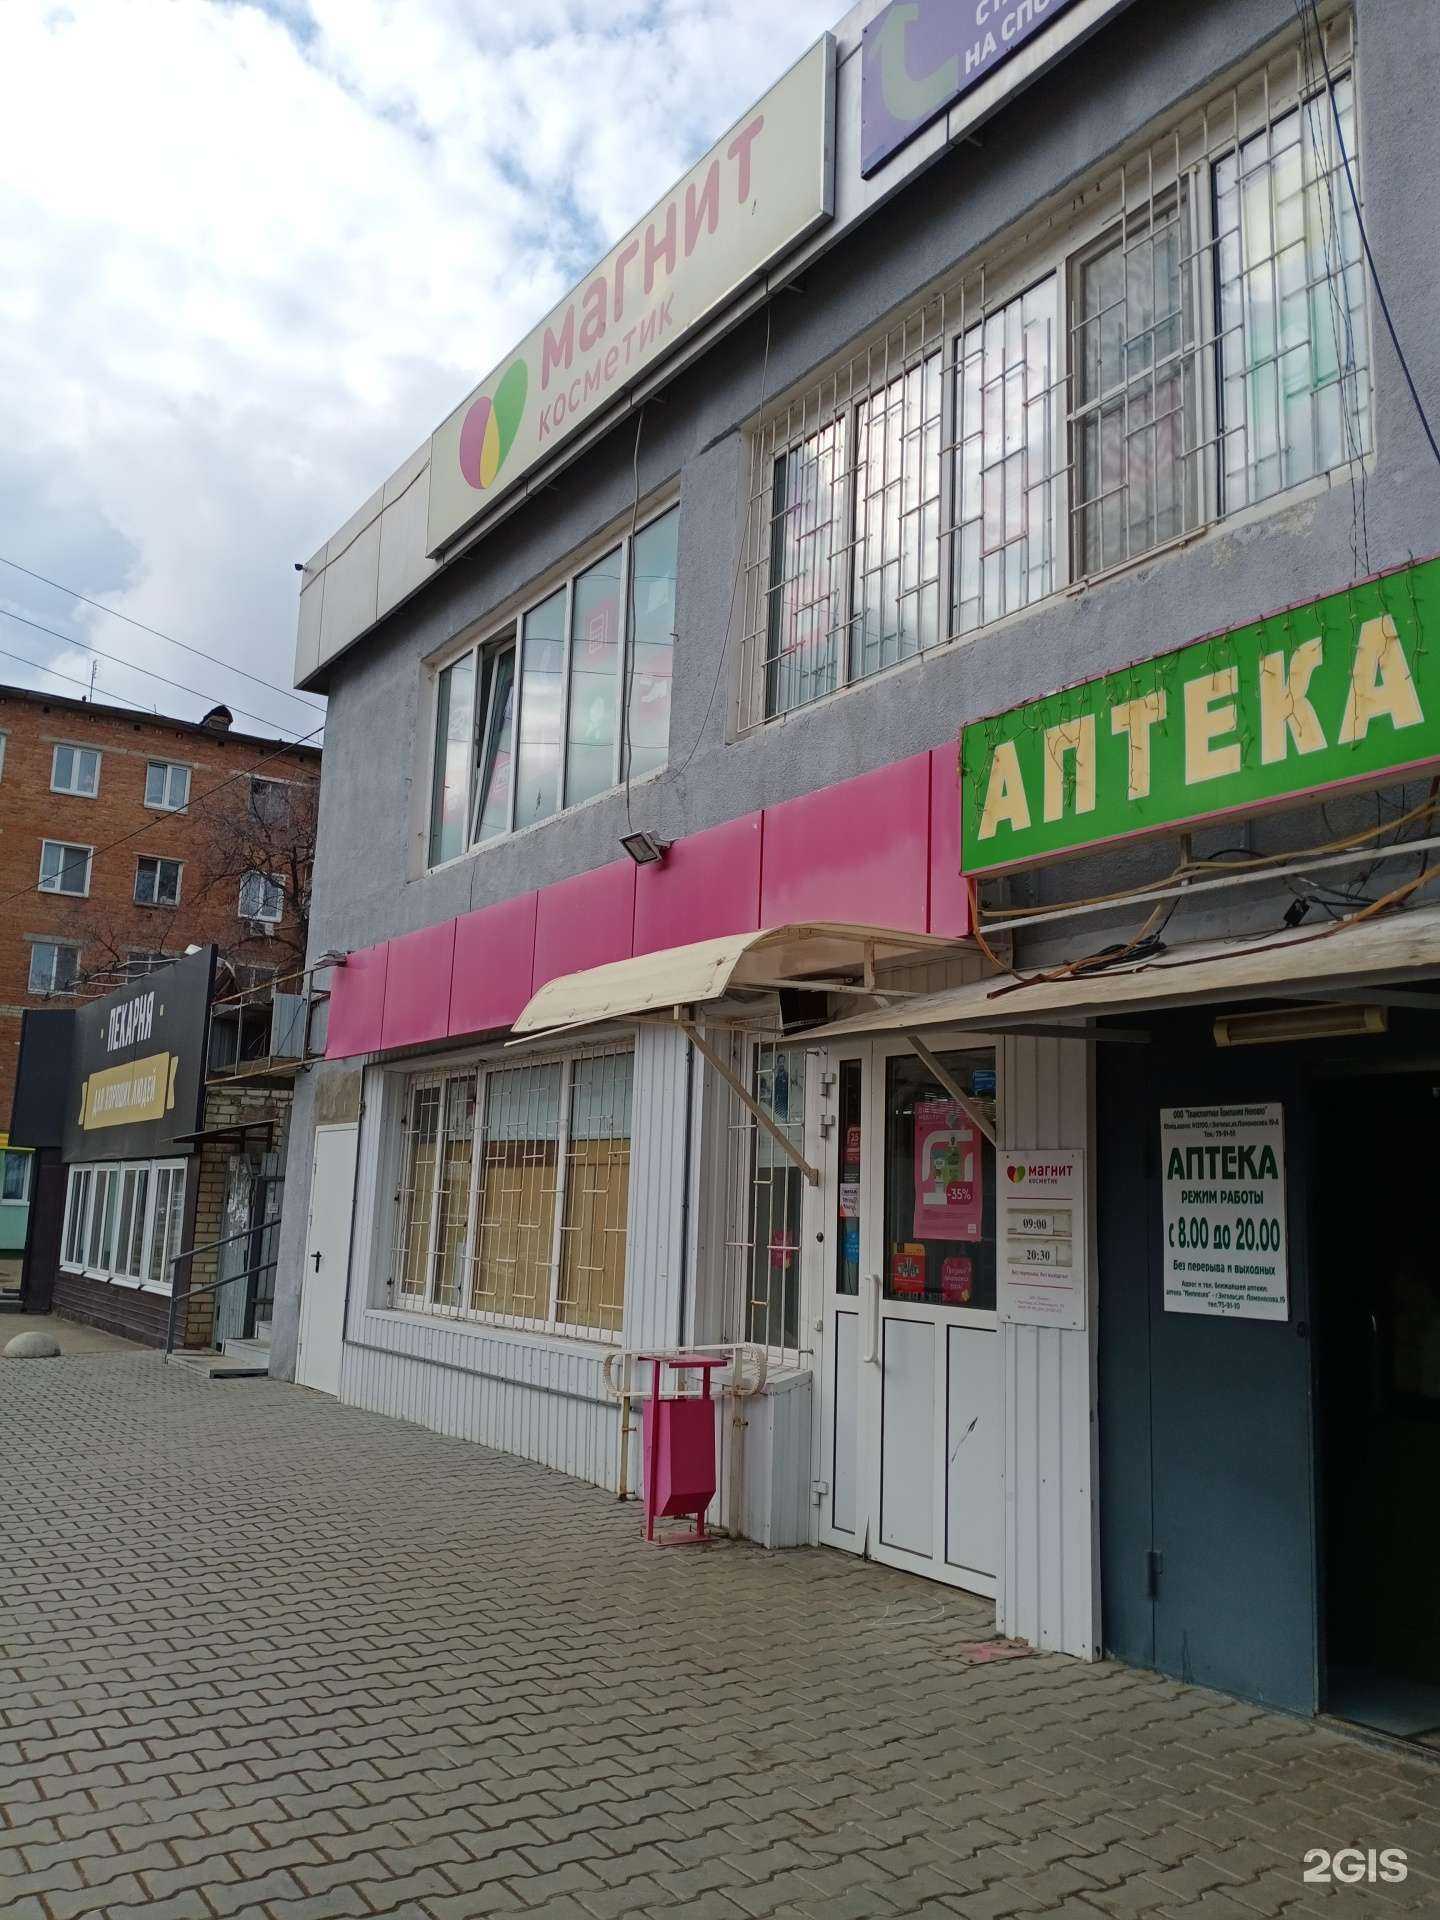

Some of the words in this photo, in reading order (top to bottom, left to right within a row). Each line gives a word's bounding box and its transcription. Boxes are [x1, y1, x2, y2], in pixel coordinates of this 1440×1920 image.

[965, 32, 998, 74] НА
[538, 291, 674, 442] косметик
[977, 613, 1425, 841] АПТЕКА
[107, 991, 155, 1052] ПЕКАРНЯ
[1167, 1145, 1279, 1181] АПТЕКА
[1181, 1190, 1217, 1204] РЕЖИМ
[1220, 1189, 1264, 1204] РАБОТЫ
[1023, 1218, 1047, 1229] 09:00
[1178, 1216, 1209, 1249] 8.00
[1213, 1224, 1231, 1250] до
[1235, 1217, 1281, 1252] 20.00
[1026, 1249, 1050, 1261] 20:30
[1173, 1260, 1186, 1271] Без
[1187, 1262, 1225, 1274] перерыва
[1228, 1265, 1232, 1273] и
[1234, 1264, 1276, 1276] выходных
